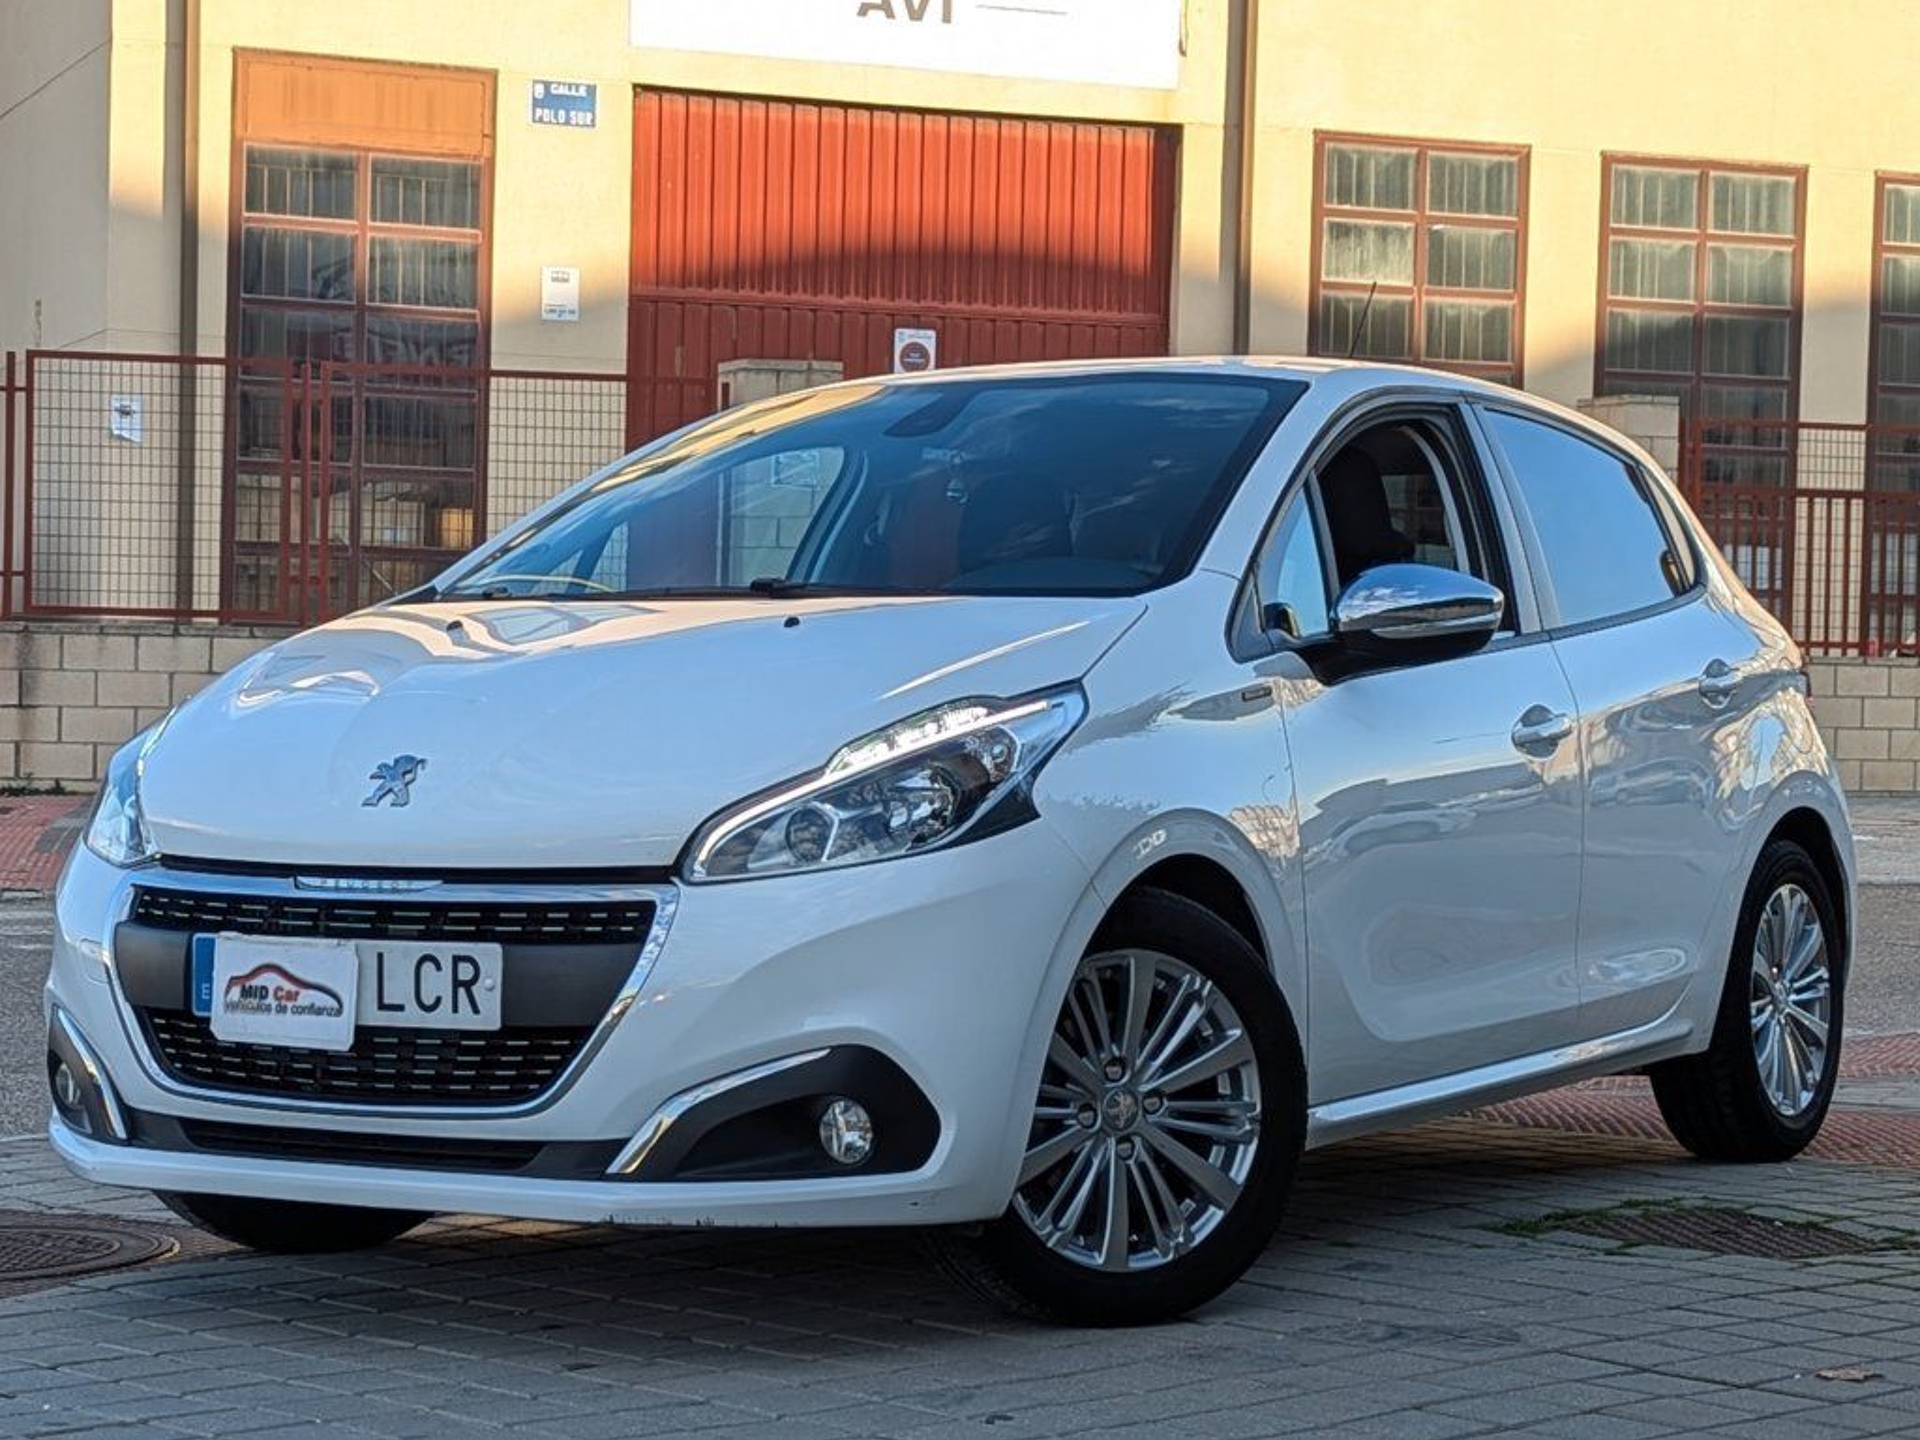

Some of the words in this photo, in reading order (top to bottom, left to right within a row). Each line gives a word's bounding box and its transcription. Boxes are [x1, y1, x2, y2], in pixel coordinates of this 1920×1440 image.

[550, 83, 588, 97] CALLE
[535, 107, 566, 124] POLO
[569, 110, 594, 126] SUR
[202, 983, 211, 999] E
[376, 951, 482, 1015] LCR
[240, 984, 269, 1000] MID
[273, 985, 300, 1003] Car
[275, 1001, 288, 1015] de
